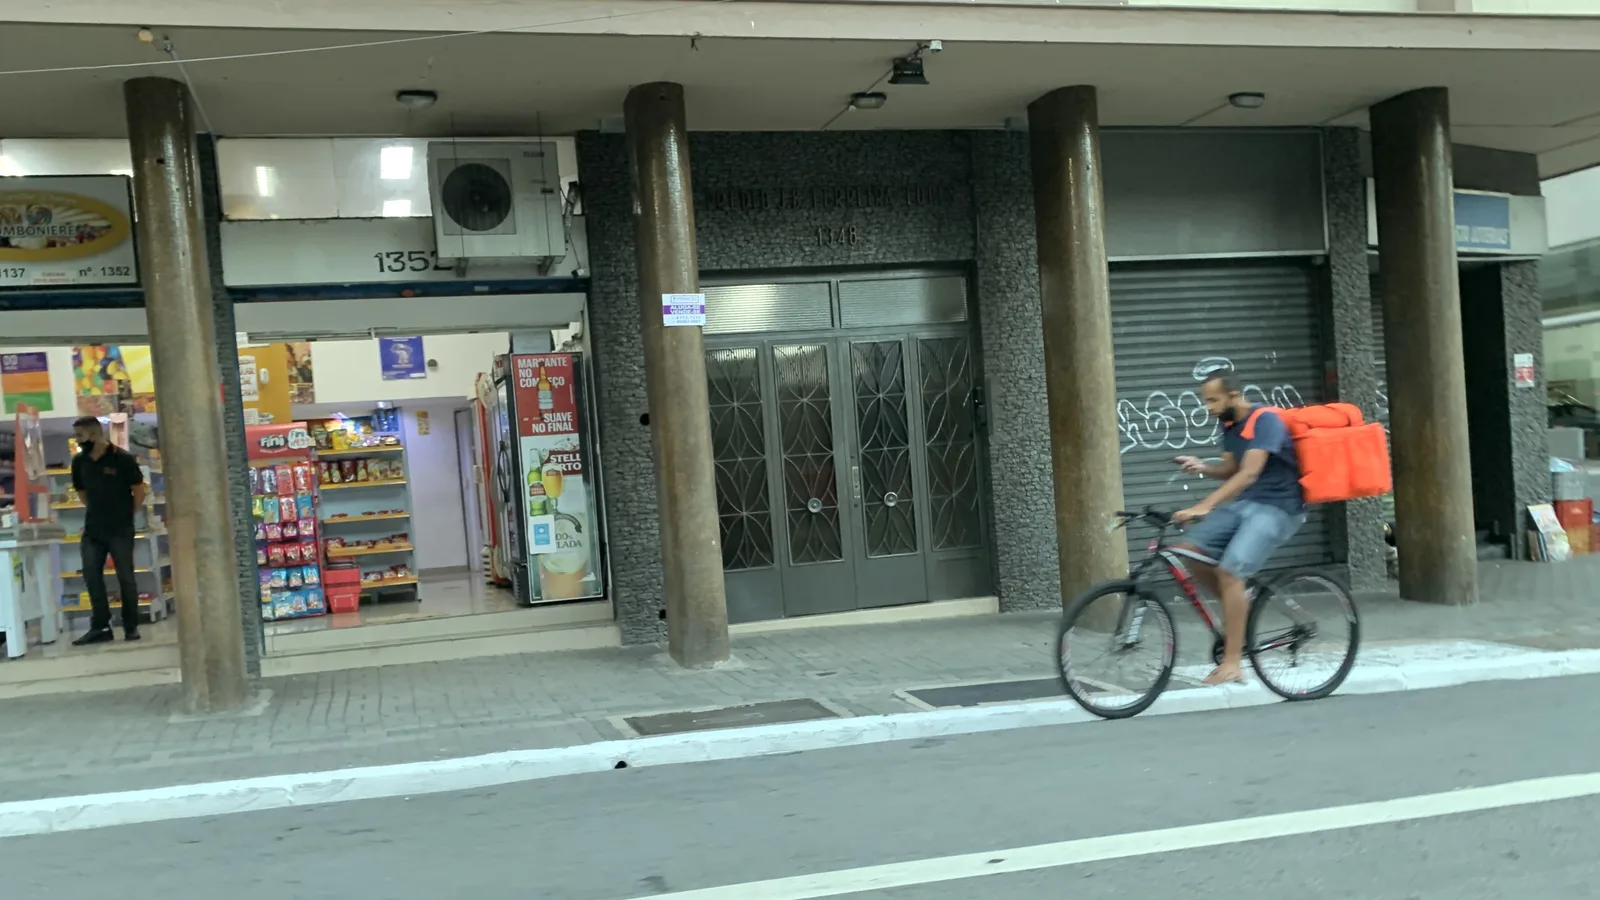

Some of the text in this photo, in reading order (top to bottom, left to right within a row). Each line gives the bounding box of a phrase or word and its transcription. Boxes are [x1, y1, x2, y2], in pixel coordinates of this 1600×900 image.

[0, 225, 76, 236] MBONIERE
[816, 225, 858, 246] 1348
[0, 268, 25, 278] 137
[101, 267, 130, 277] 1352
[519, 368, 532, 378] NO
[543, 412, 573, 423] SUAVE
[532, 422, 574, 433] NO FINAL
[561, 462, 582, 471] RTO
[556, 540, 582, 549] LADA
